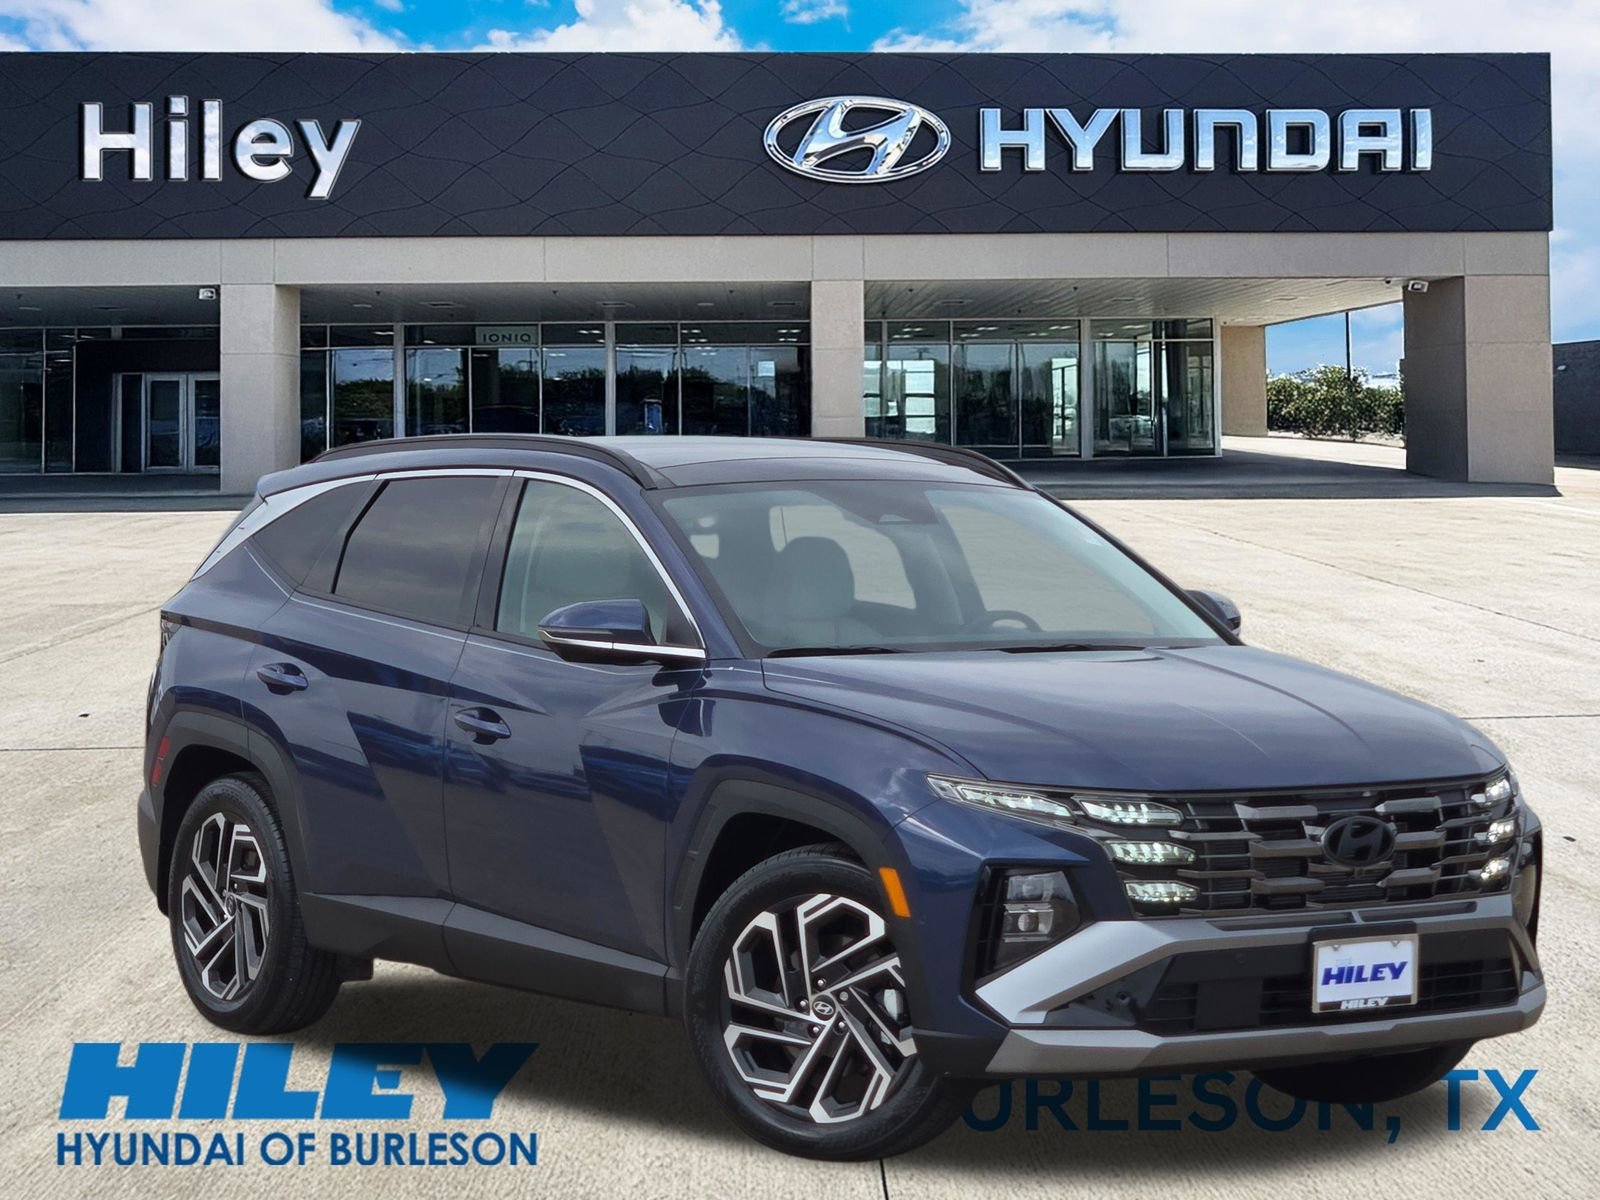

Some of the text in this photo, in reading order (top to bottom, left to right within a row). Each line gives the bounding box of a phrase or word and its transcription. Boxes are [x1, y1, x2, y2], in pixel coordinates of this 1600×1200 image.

[80, 95, 361, 200] Hiley
[979, 107, 1434, 173] HYUNDAI
[1321, 961, 1408, 985] HILEY
